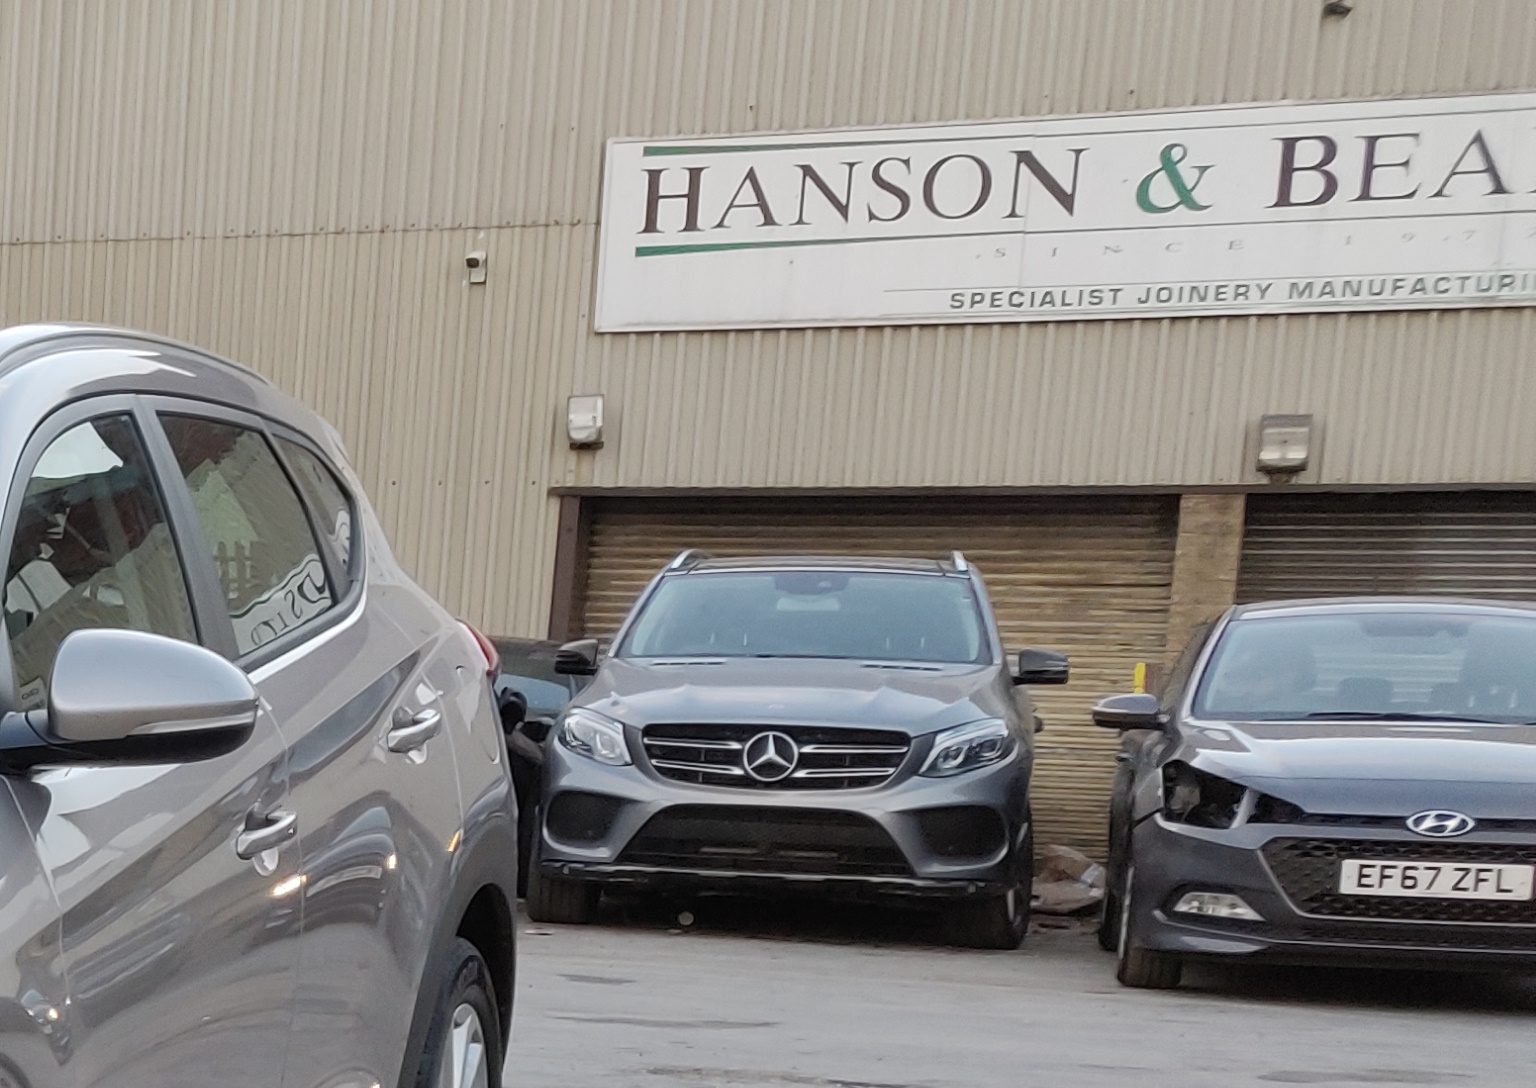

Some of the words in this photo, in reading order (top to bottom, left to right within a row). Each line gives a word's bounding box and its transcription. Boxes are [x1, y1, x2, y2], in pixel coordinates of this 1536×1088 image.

[636, 148, 1090, 234] HANSON
[1135, 143, 1216, 214] &
[1264, 128, 1536, 209] BEA
[949, 287, 1124, 309] SPECIALIST
[1137, 282, 1274, 305] JOINERY
[1289, 274, 1536, 300] MANUFACTURI
[1357, 864, 1442, 890] EF67
[1451, 867, 1514, 893] ZFL
